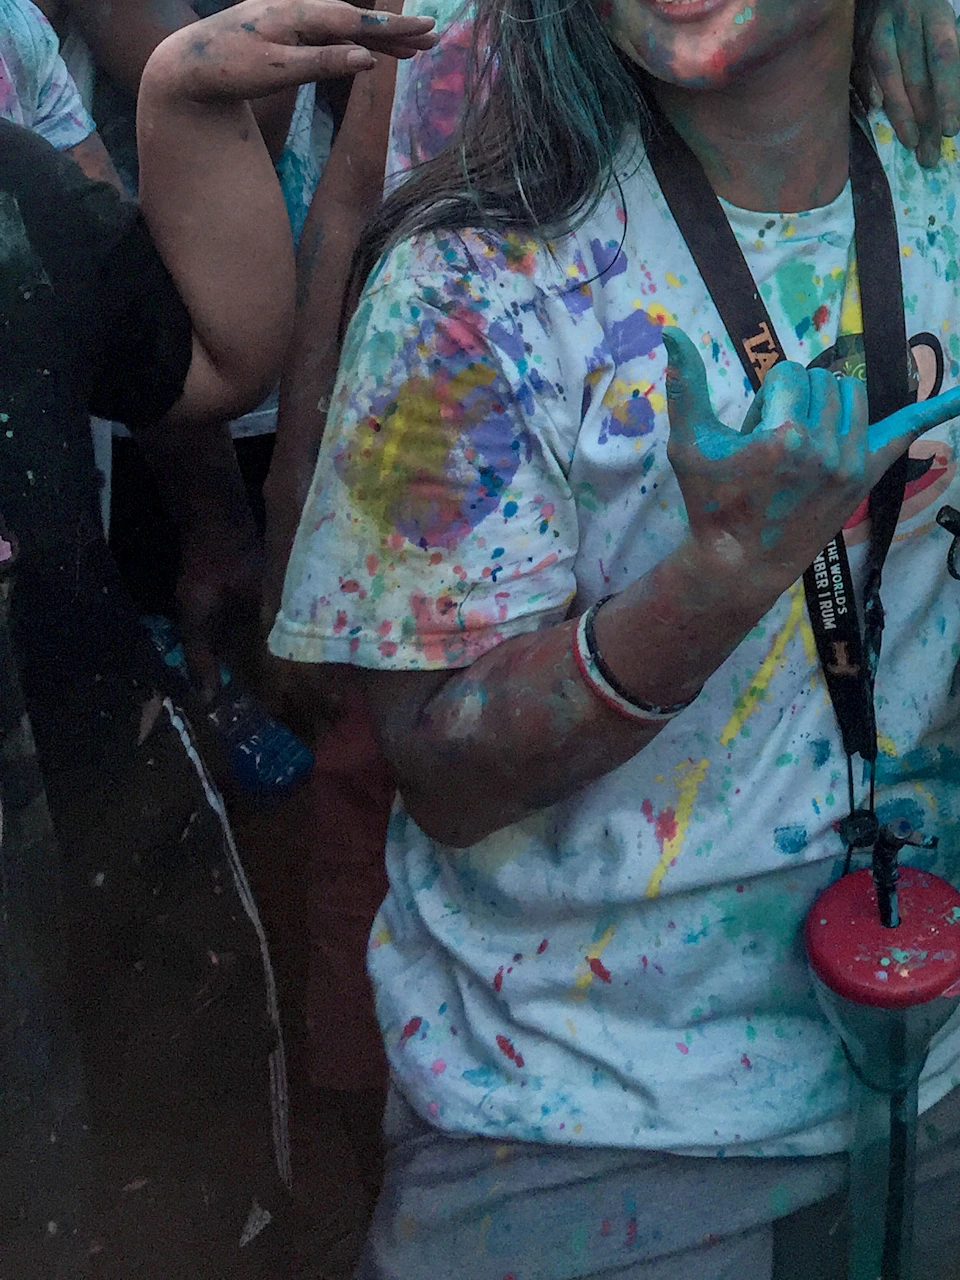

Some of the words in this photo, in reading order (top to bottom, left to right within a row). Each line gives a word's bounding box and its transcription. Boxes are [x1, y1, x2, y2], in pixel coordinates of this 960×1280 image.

[827, 539, 840, 562] THE
[818, 591, 831, 599] 1
[830, 562, 848, 615] WORLD'S
[819, 600, 837, 630] RUM
